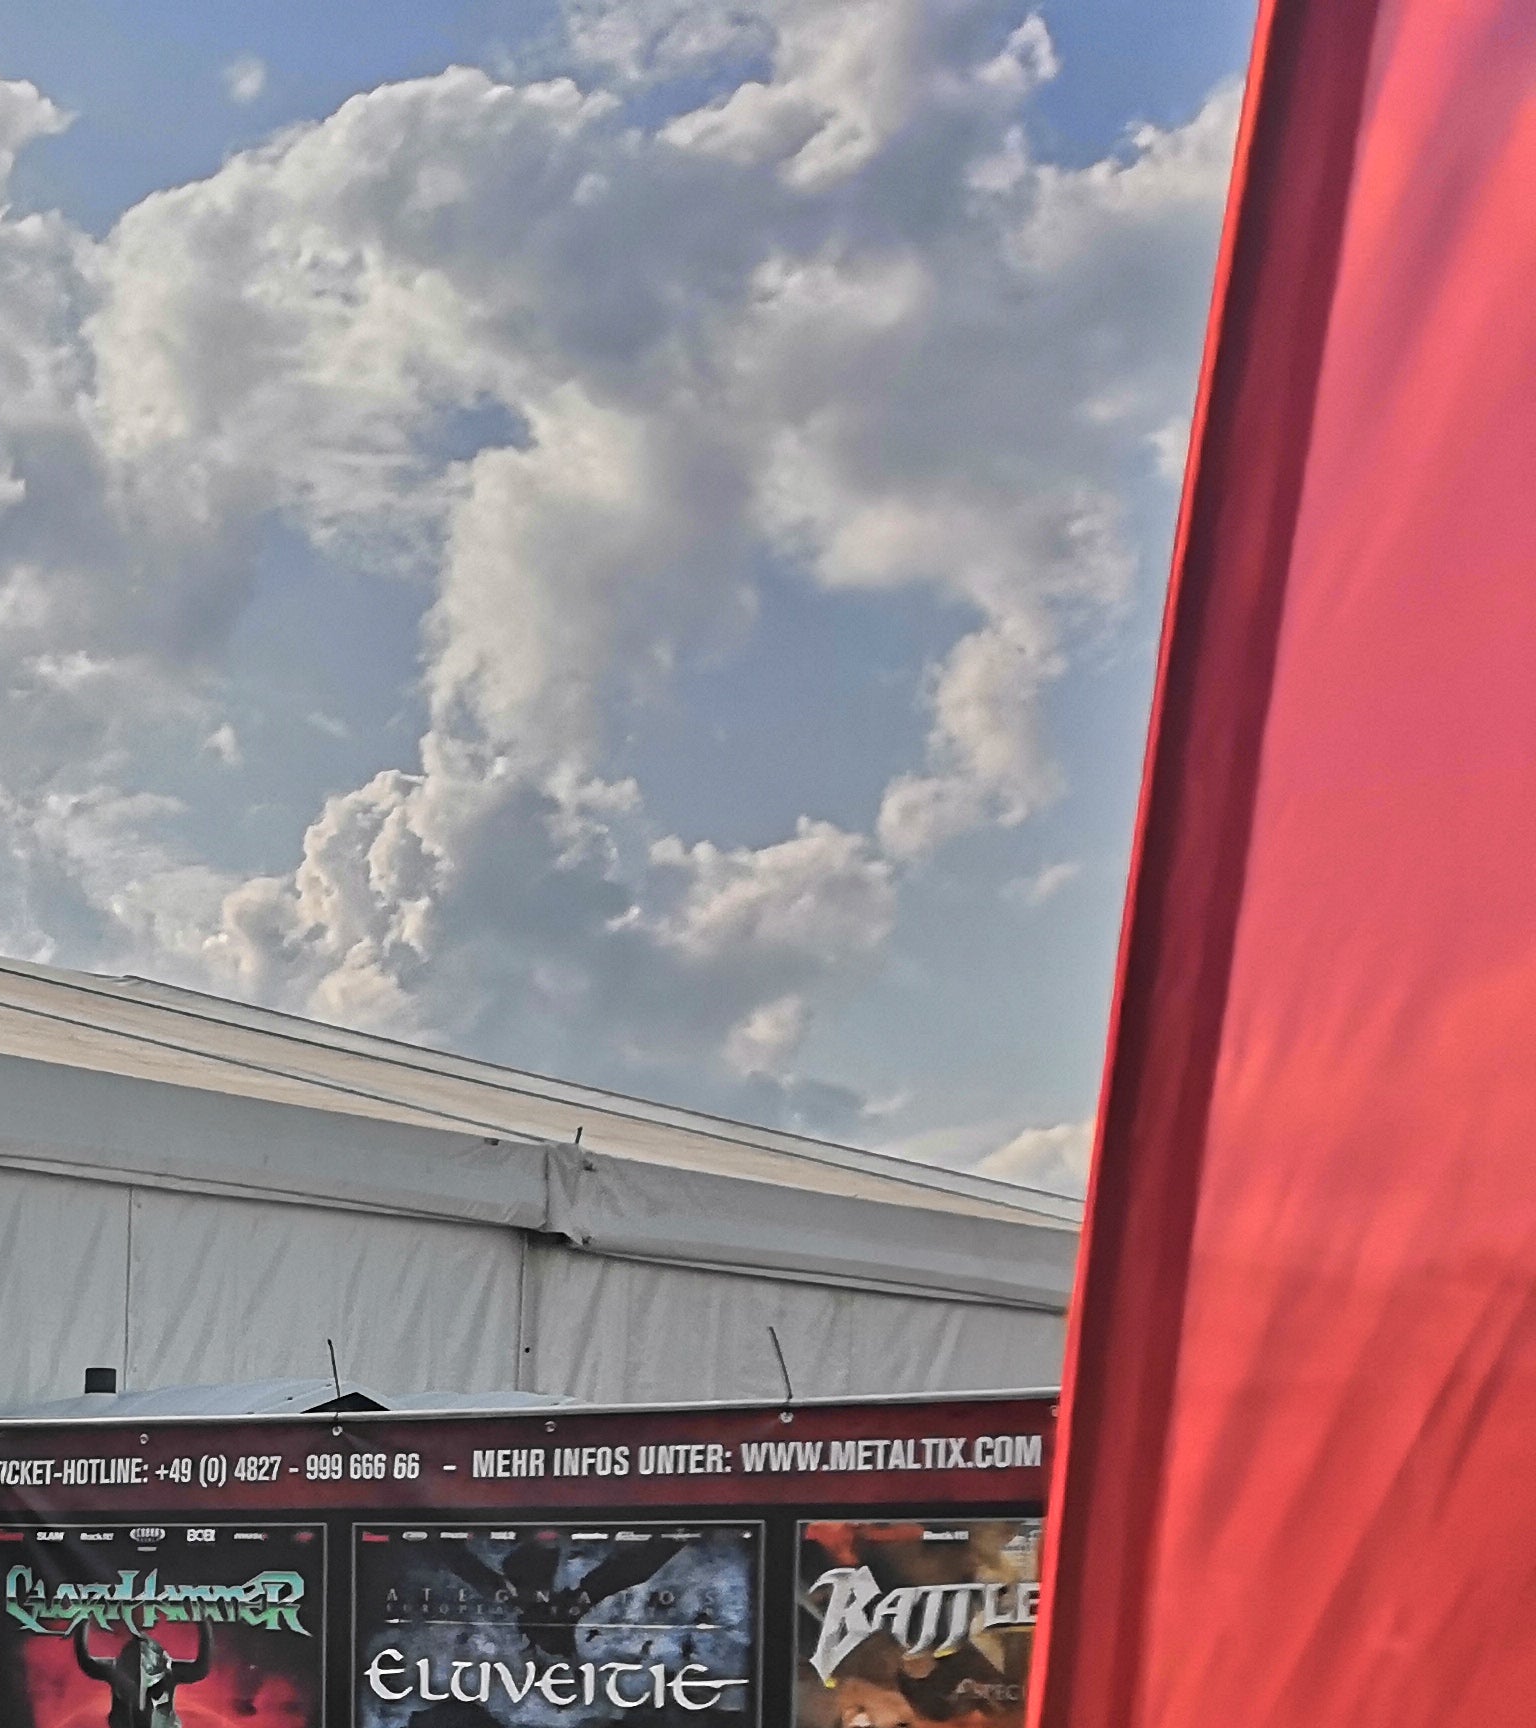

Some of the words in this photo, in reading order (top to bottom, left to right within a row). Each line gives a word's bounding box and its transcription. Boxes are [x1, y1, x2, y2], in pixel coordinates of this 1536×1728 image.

[154, 1457, 192, 1483] +49
[199, 1454, 227, 1488] (0)
[234, 1456, 281, 1482] 4827
[306, 1455, 345, 1481] 999
[349, 1454, 387, 1480] 666
[392, 1453, 420, 1479] 66
[473, 1449, 545, 1479] MEHR
[553, 1446, 629, 1476] INFOS
[638, 1443, 732, 1474] UNTER:
[741, 1435, 1042, 1472] WWW.METALTIX.COM
